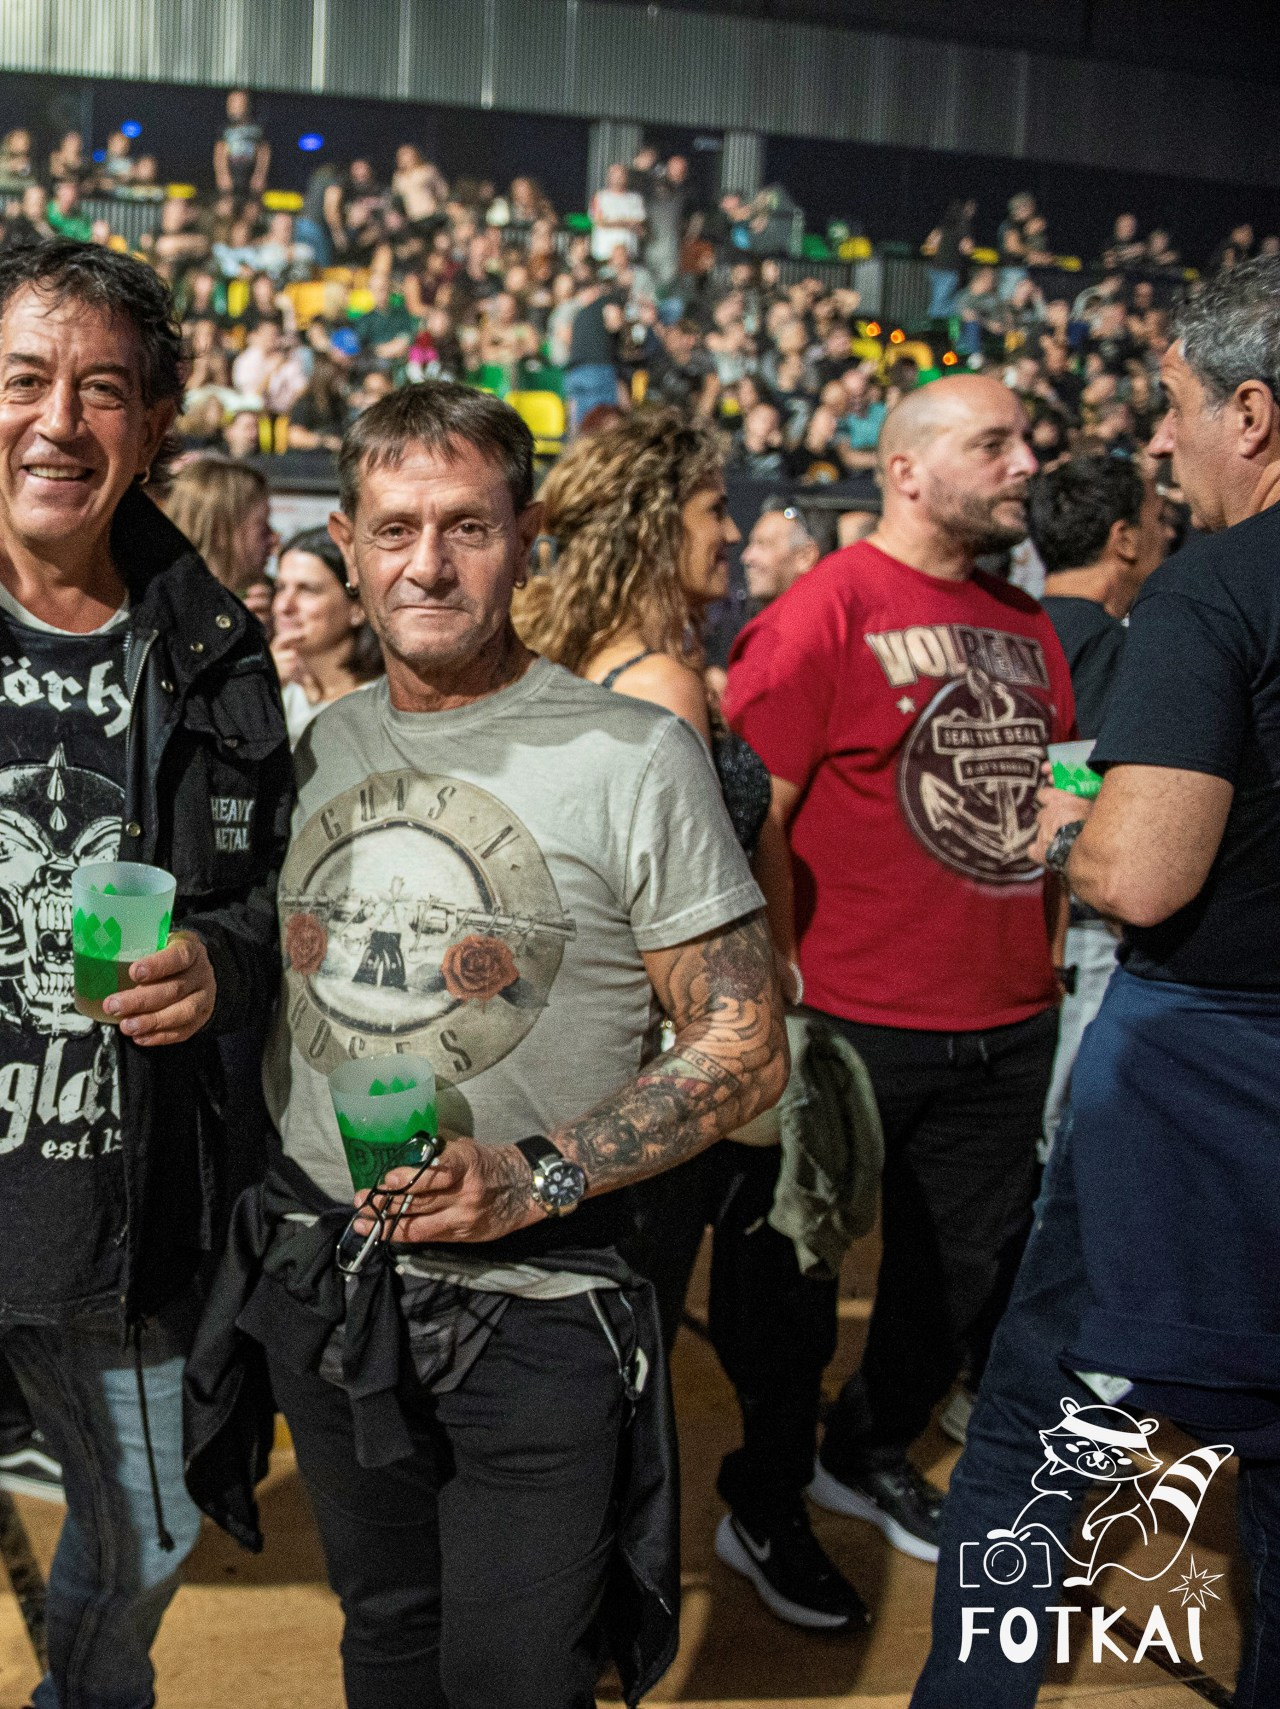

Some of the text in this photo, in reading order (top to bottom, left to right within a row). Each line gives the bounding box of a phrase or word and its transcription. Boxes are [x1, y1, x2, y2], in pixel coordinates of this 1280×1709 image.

[864, 624, 1050, 691] VOLBEAT
[976, 728, 1002, 746] THE
[1003, 726, 1040, 745] DEAL
[210, 797, 255, 824] HEAVY
[320, 777, 457, 842] GUNS
[41, 1131, 95, 1161] est.
